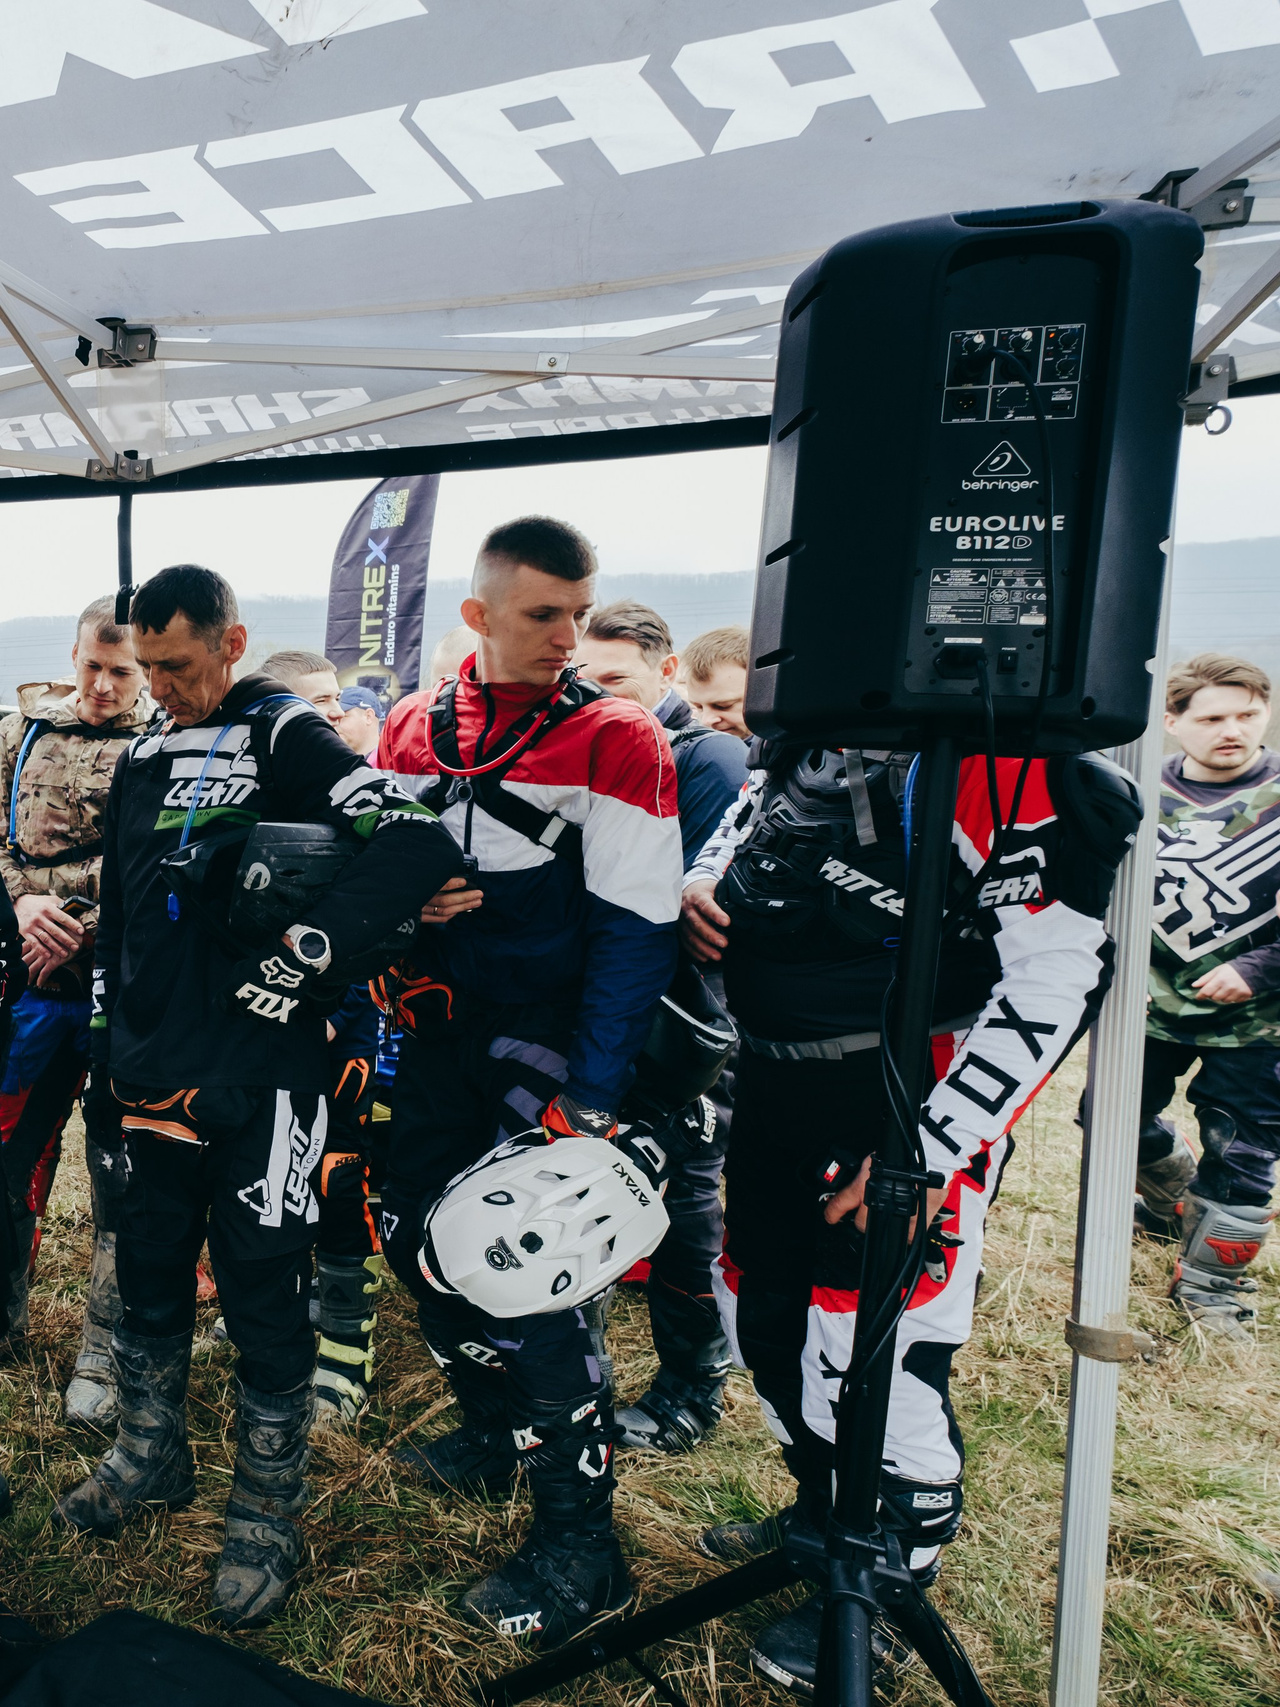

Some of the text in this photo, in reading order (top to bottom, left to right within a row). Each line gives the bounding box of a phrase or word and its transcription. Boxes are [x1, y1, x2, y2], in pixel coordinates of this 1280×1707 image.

[962, 479, 1039, 492] behringer
[929, 515, 1065, 532] EUROLIVE
[956, 535, 1032, 550] B112D
[358, 536, 390, 667] NITREX
[384, 564, 400, 666] Enduro vitamins
[235, 982, 299, 1024] FOX
[920, 997, 1059, 1157] FOX
[302, 1138, 321, 1172] TOWN
[498, 1611, 542, 1636] GTX
